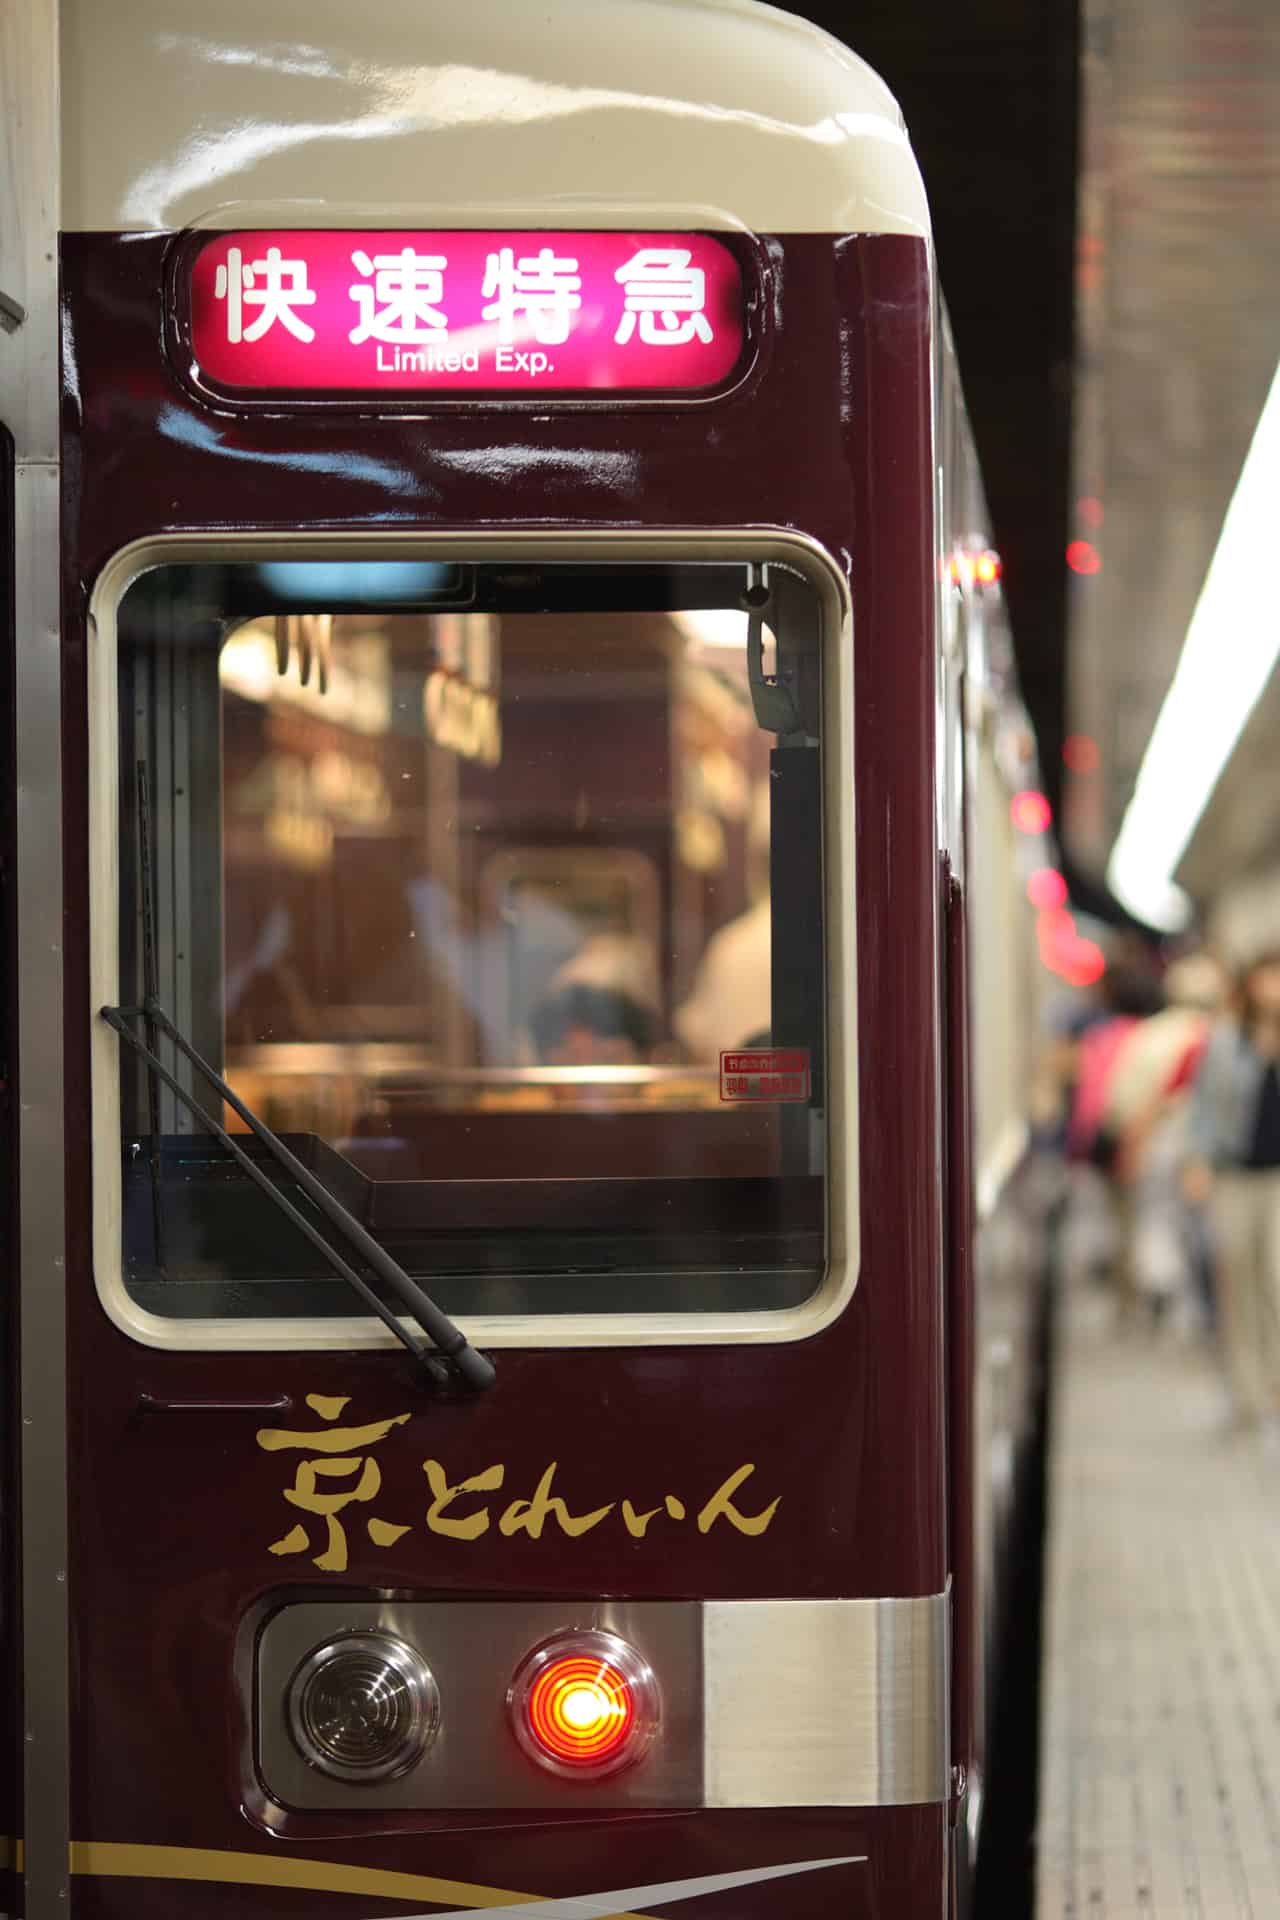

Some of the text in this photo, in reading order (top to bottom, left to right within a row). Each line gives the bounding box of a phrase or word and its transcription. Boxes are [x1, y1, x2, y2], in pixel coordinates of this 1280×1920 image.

[215, 248, 714, 345] 快速特急
[376, 346, 554, 377] Limited Exp.
[256, 1393, 782, 1572] 京とれいん
